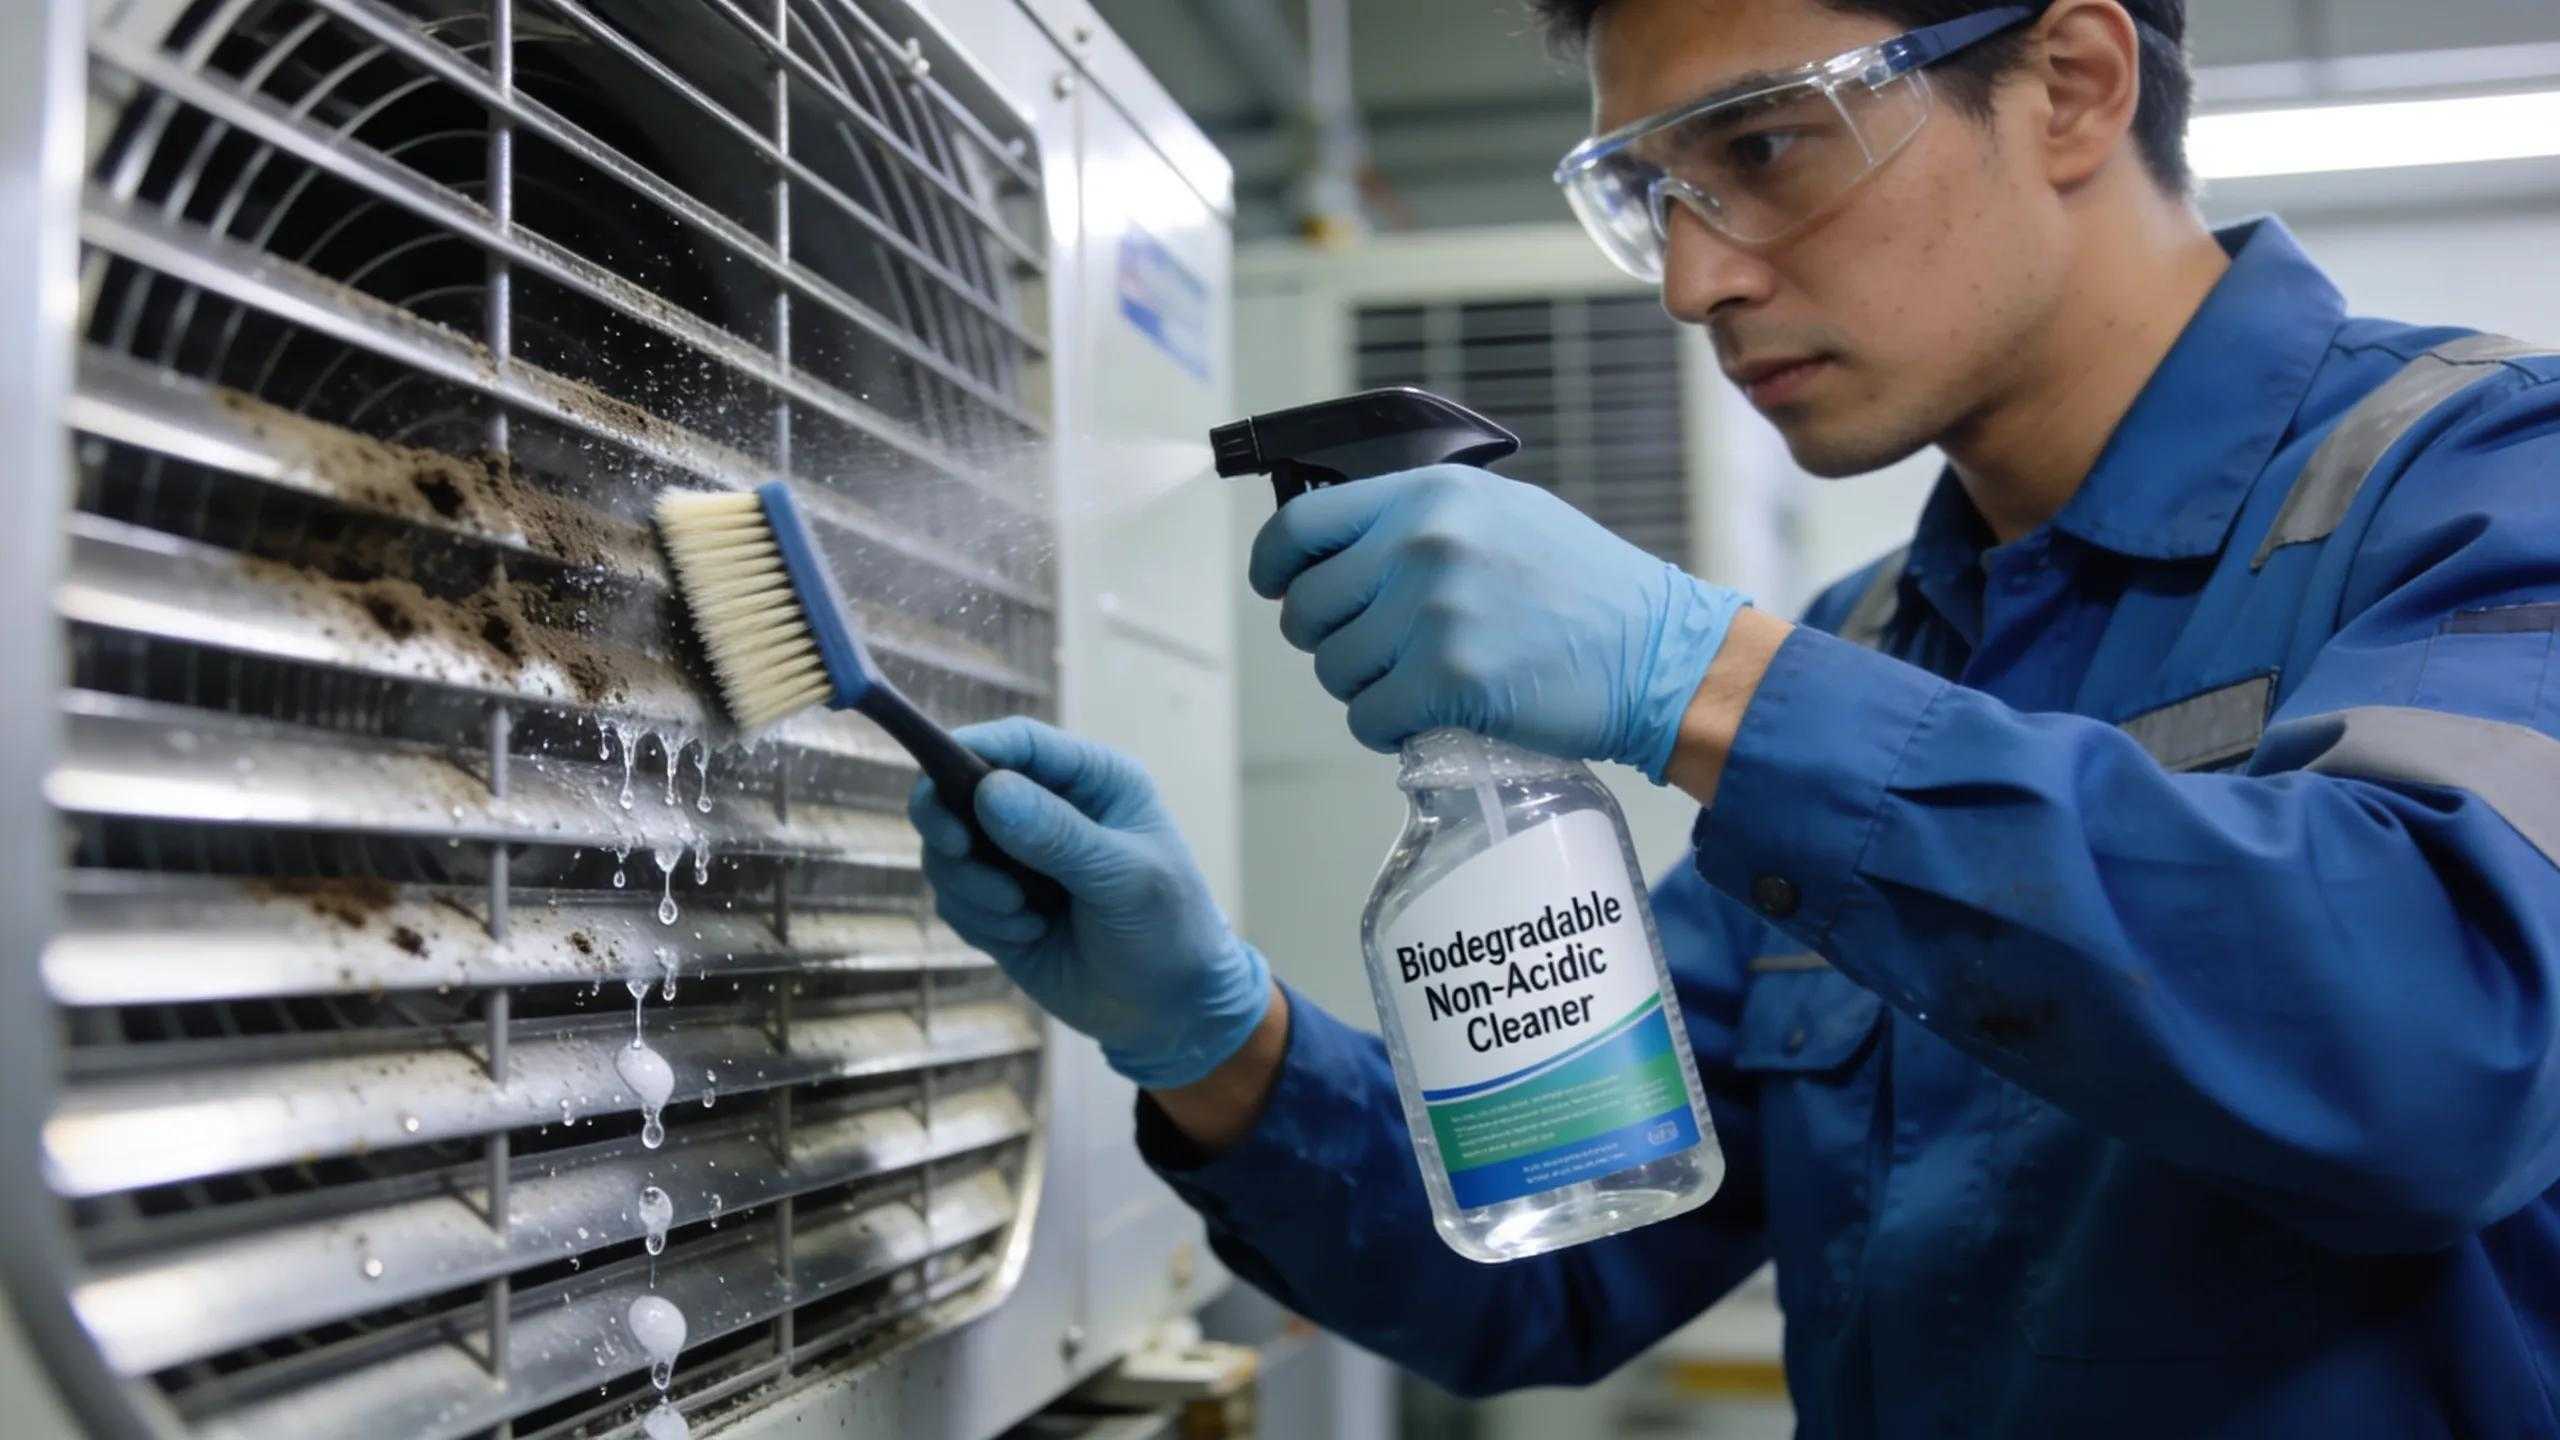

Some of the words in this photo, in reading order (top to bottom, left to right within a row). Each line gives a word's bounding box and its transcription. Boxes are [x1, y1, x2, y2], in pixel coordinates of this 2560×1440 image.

[1397, 890, 1622, 983] Biodegradable
[1424, 944, 1608, 1021] Non-Acidic
[1466, 993, 1595, 1053] Cleaner
